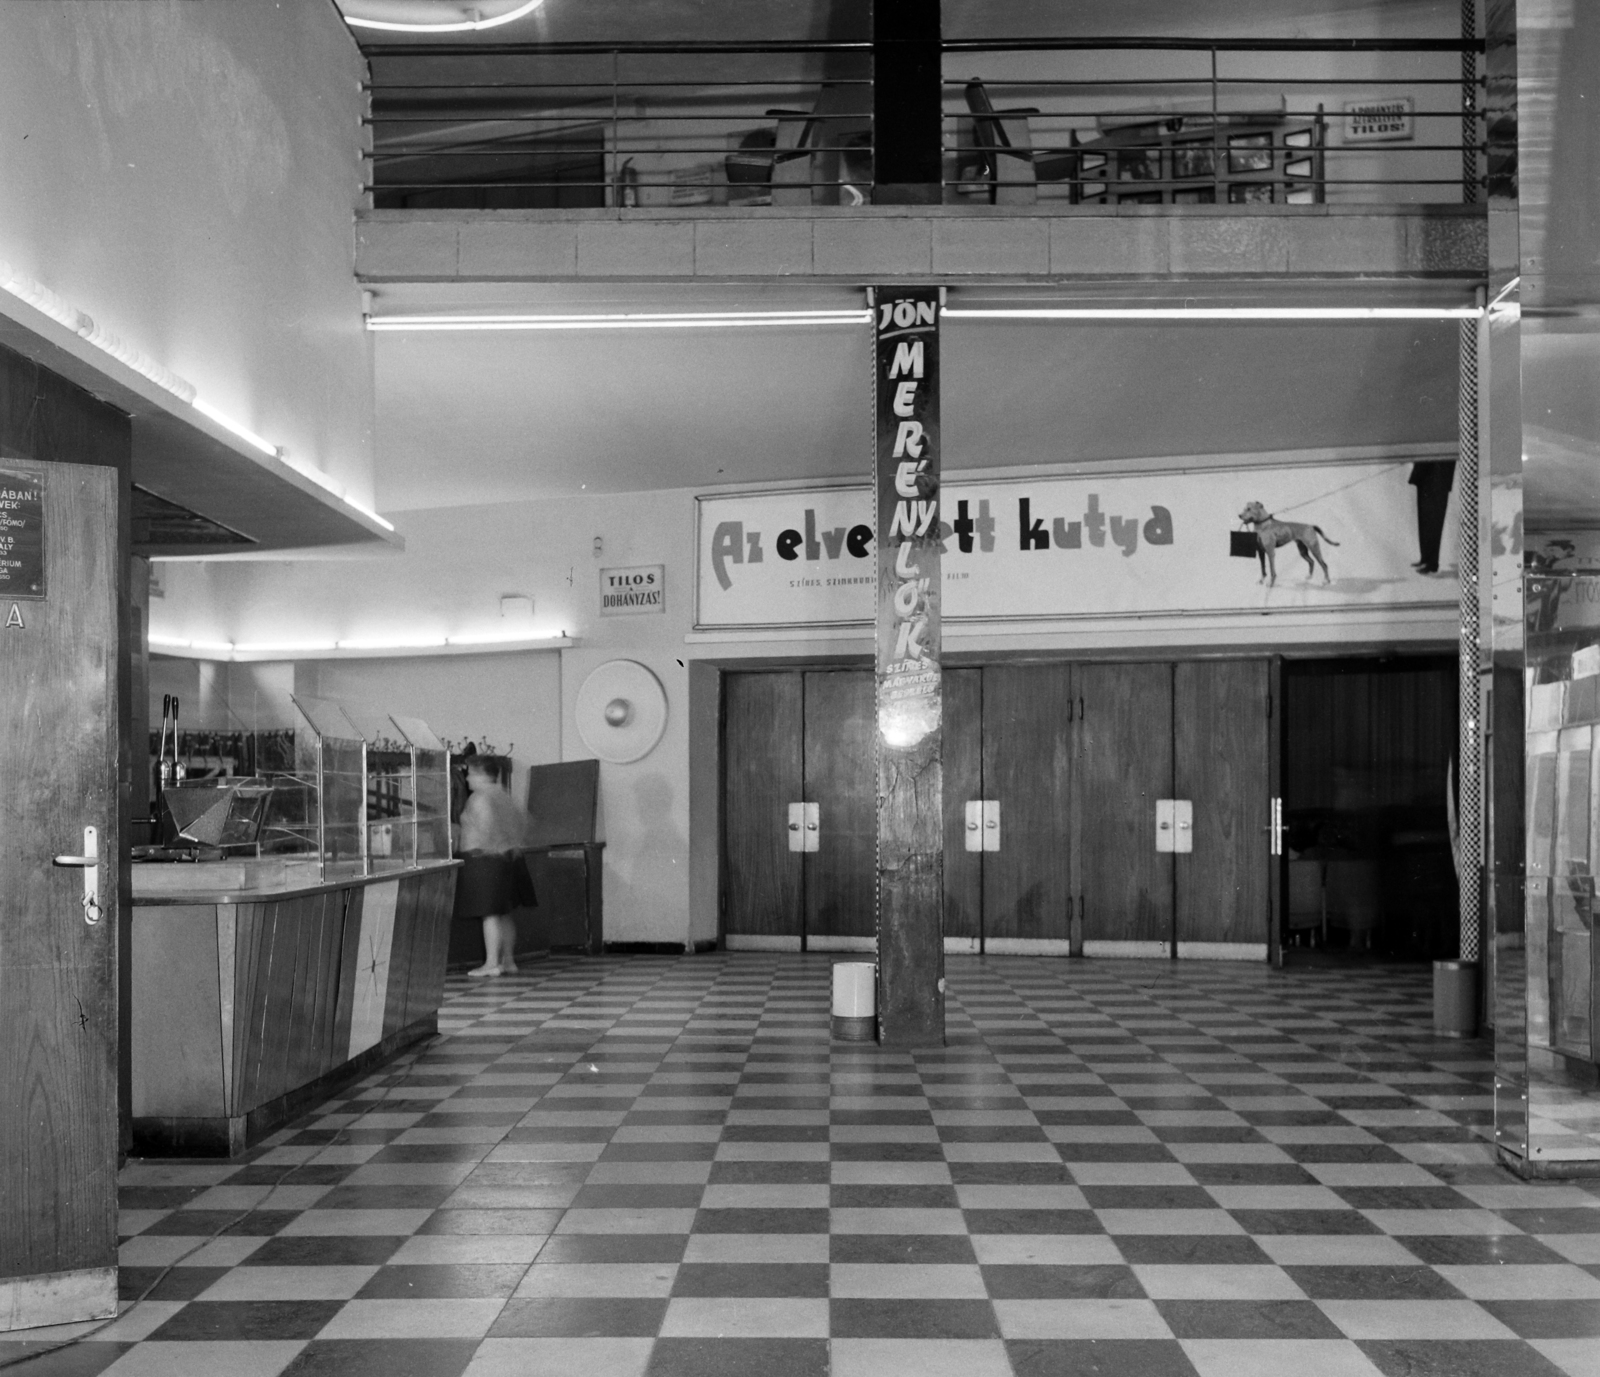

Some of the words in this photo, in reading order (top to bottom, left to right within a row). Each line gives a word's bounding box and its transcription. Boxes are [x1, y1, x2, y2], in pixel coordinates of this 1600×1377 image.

[1351, 123, 1405, 134] TILOS!
[878, 298, 937, 331] JÖN
[711, 519, 764, 591] Az
[1019, 493, 1175, 558] kutya
[608, 573, 655, 586] TILOS
[5, 603, 25, 629] A
